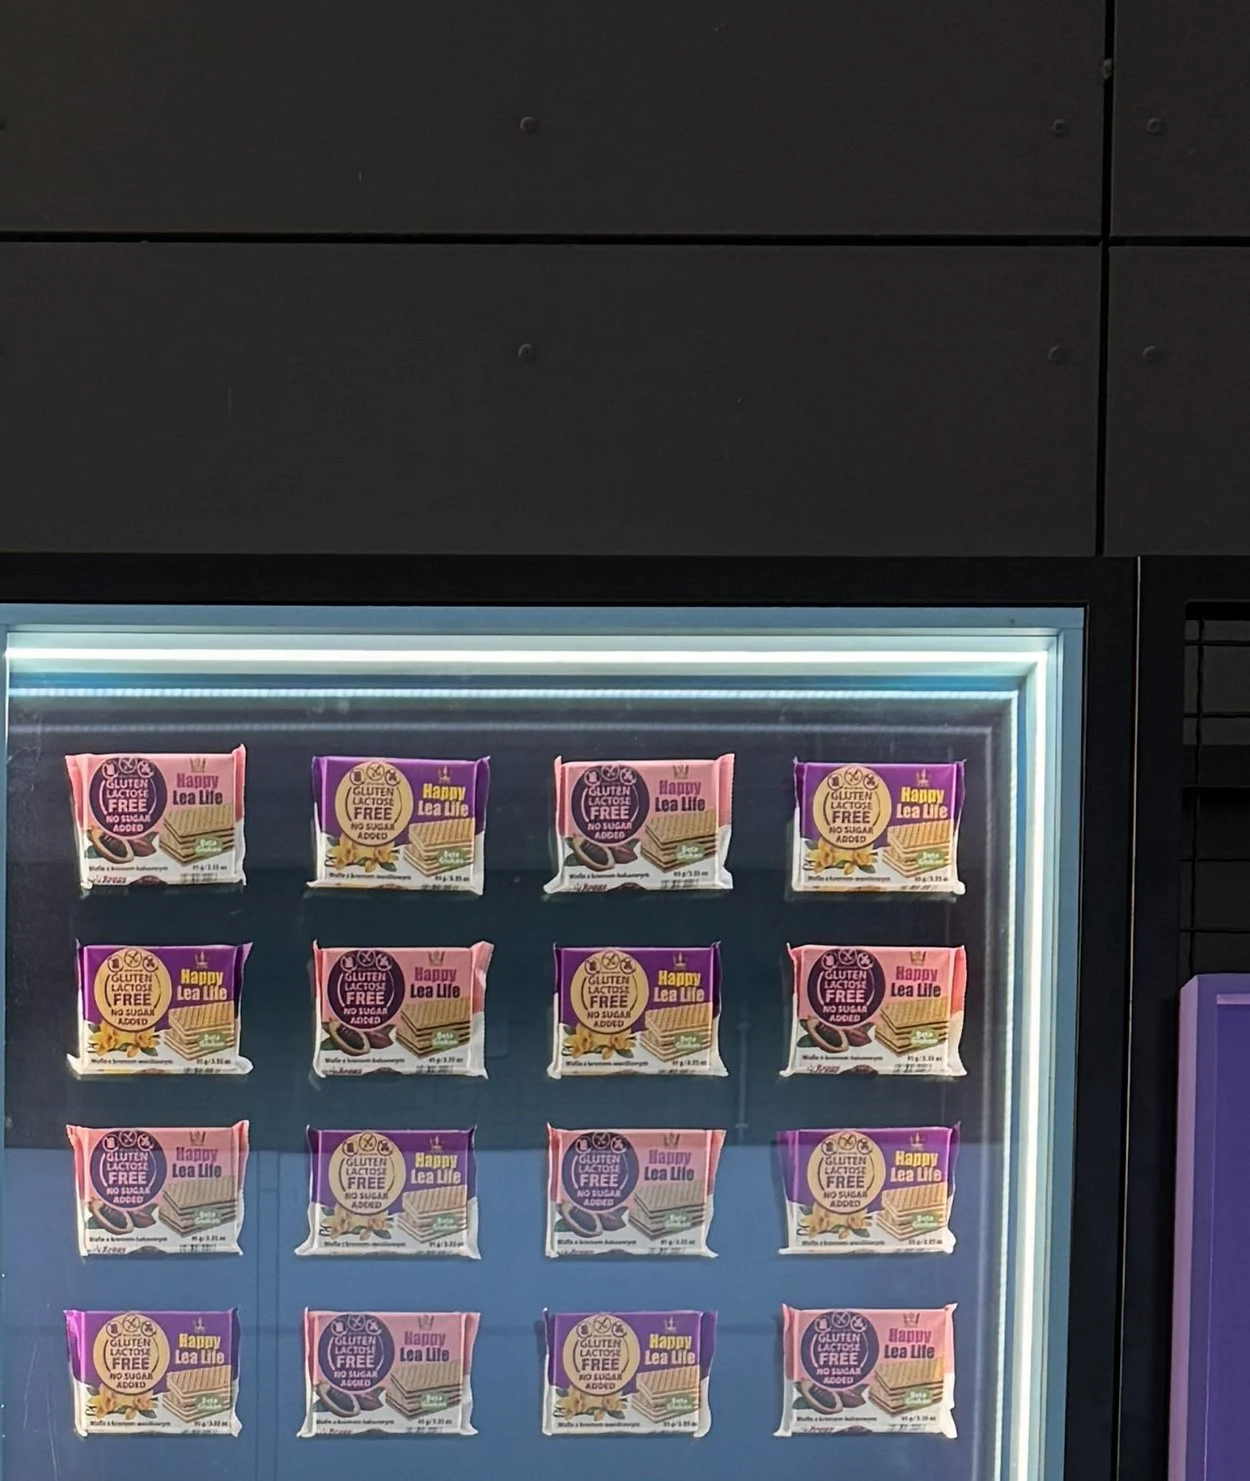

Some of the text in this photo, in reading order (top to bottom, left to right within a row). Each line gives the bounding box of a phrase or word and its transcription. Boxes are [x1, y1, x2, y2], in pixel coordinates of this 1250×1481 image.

[106, 779, 148, 789] GLUTEN
[588, 786, 631, 796] GLUTEN
[423, 784, 466, 800] Happy
[901, 786, 944, 804] Happy
[108, 800, 147, 812] FREE
[418, 800, 469, 817] Lea Life
[591, 806, 630, 819] FREE
[896, 803, 948, 820] Lea Life
[354, 808, 392, 820] FREE
[832, 811, 871, 824] FREE
[180, 968, 224, 986] Happy
[344, 971, 387, 982] GLUTEN
[658, 970, 702, 987] Happy
[824, 969, 867, 981] GLUTEN
[113, 993, 151, 1006] FREE
[176, 984, 227, 1001] Lea Life
[346, 992, 385, 1006] FREE
[653, 987, 706, 1003] Lea Life
[826, 989, 865, 1004] FREE
[589, 995, 628, 1008] FREE
[107, 1151, 148, 1161] GLUTEN
[416, 1152, 458, 1169] Happy
[578, 1153, 621, 1164] GLUTEN
[895, 1150, 939, 1167] Happy
[109, 1171, 146, 1184] FREE
[411, 1169, 462, 1185] Lea Life
[580, 1174, 619, 1188] FREE
[890, 1167, 943, 1183] Lea Life
[348, 1177, 385, 1190] FREE
[826, 1176, 865, 1189] FREE
[179, 1332, 221, 1350] Happy
[334, 1336, 376, 1346] GLUTEN
[650, 1333, 692, 1350] Happy
[818, 1333, 860, 1343] GLUTEN
[112, 1357, 150, 1370] FREE
[174, 1349, 225, 1365] Lea Life
[336, 1355, 374, 1369] FREE
[645, 1350, 696, 1366] Lea Life
[820, 1352, 858, 1366] FREE
[582, 1358, 620, 1371] FREE
